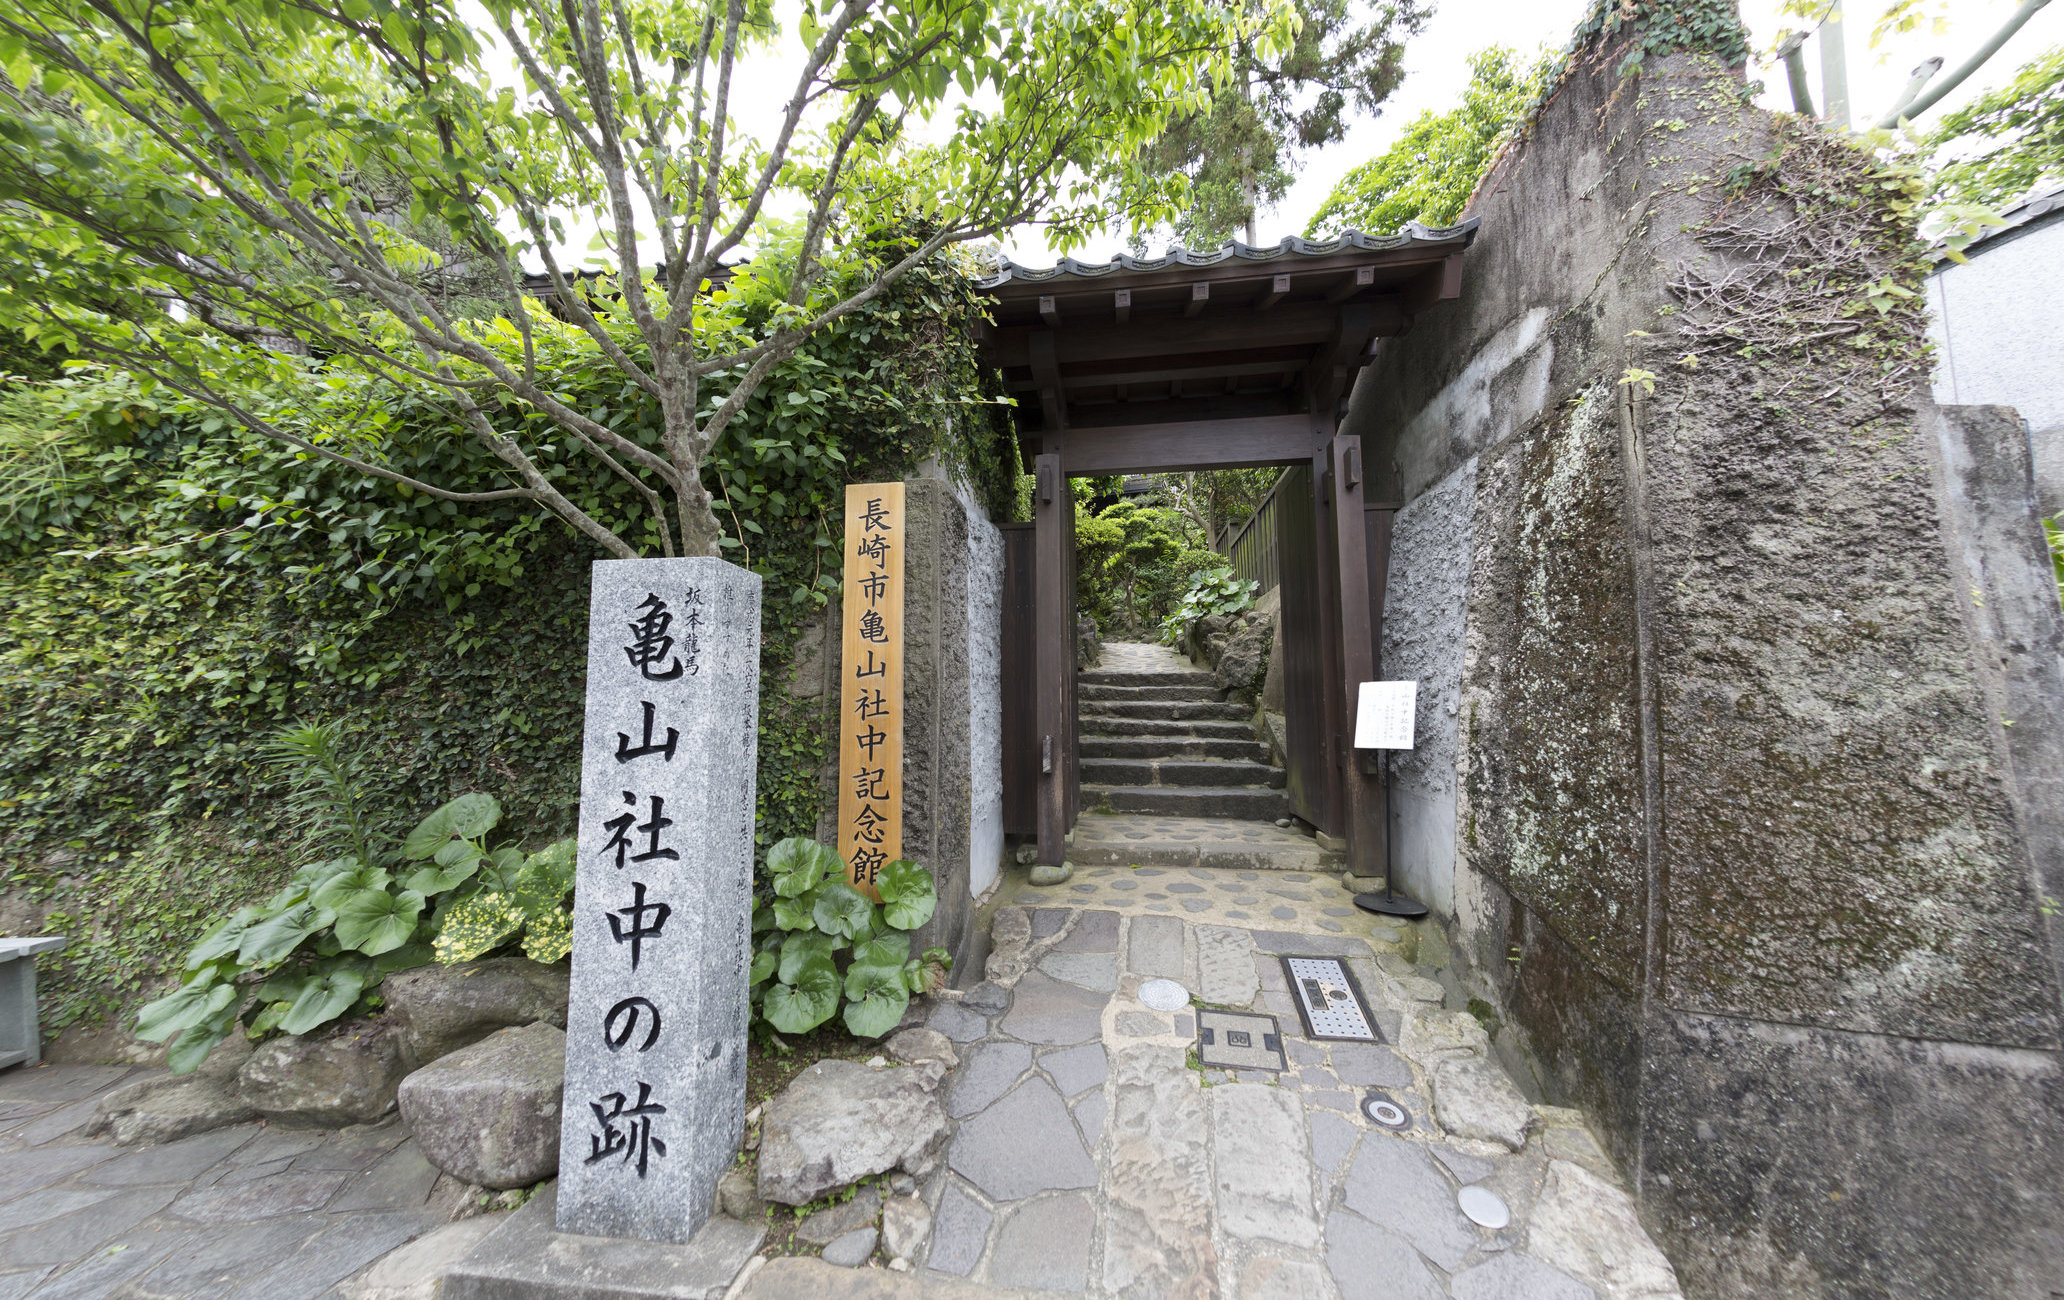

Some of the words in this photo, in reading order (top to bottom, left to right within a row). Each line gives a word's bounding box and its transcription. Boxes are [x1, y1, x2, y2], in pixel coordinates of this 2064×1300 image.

[681, 587, 705, 677] 坂本龍馬
[849, 497, 893, 887] 長崎市亀山社中記念館
[583, 592, 684, 1180] 亀山社中の跡
